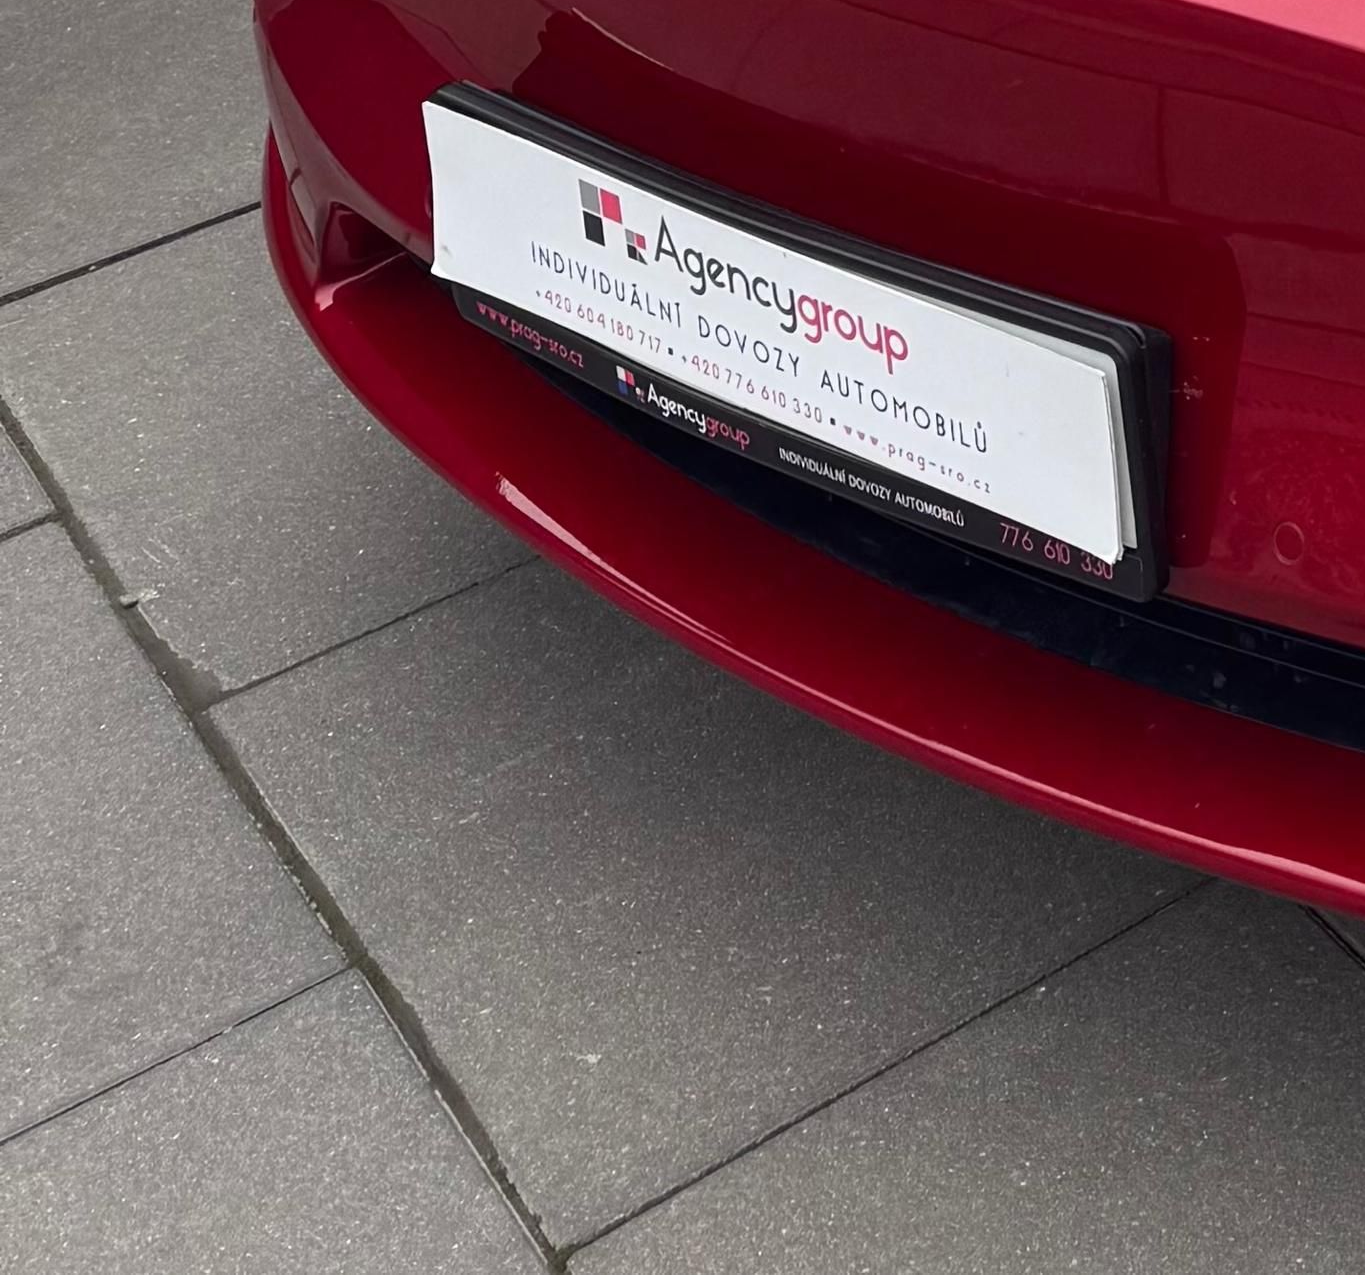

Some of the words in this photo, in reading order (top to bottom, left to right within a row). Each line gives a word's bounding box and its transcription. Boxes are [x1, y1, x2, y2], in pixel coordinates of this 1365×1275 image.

[654, 215, 909, 375] Agencygroup
[531, 240, 682, 328] INDIVIDUÁLNÍ
[698, 315, 800, 377] DOVOZY
[820, 369, 988, 453] AUTOMOBILŮ
[577, 303, 606, 329] 604
[610, 318, 634, 340] 180
[639, 330, 661, 354] 717
[725, 368, 755, 394] 776
[761, 385, 786, 408] 610
[793, 397, 823, 423] 330
[648, 382, 750, 450] Agencygroup
[849, 473, 892, 501] DOVOZY
[1000, 522, 1034, 552] 776
[1044, 539, 1071, 565] 610
[1080, 551, 1113, 580] 330
